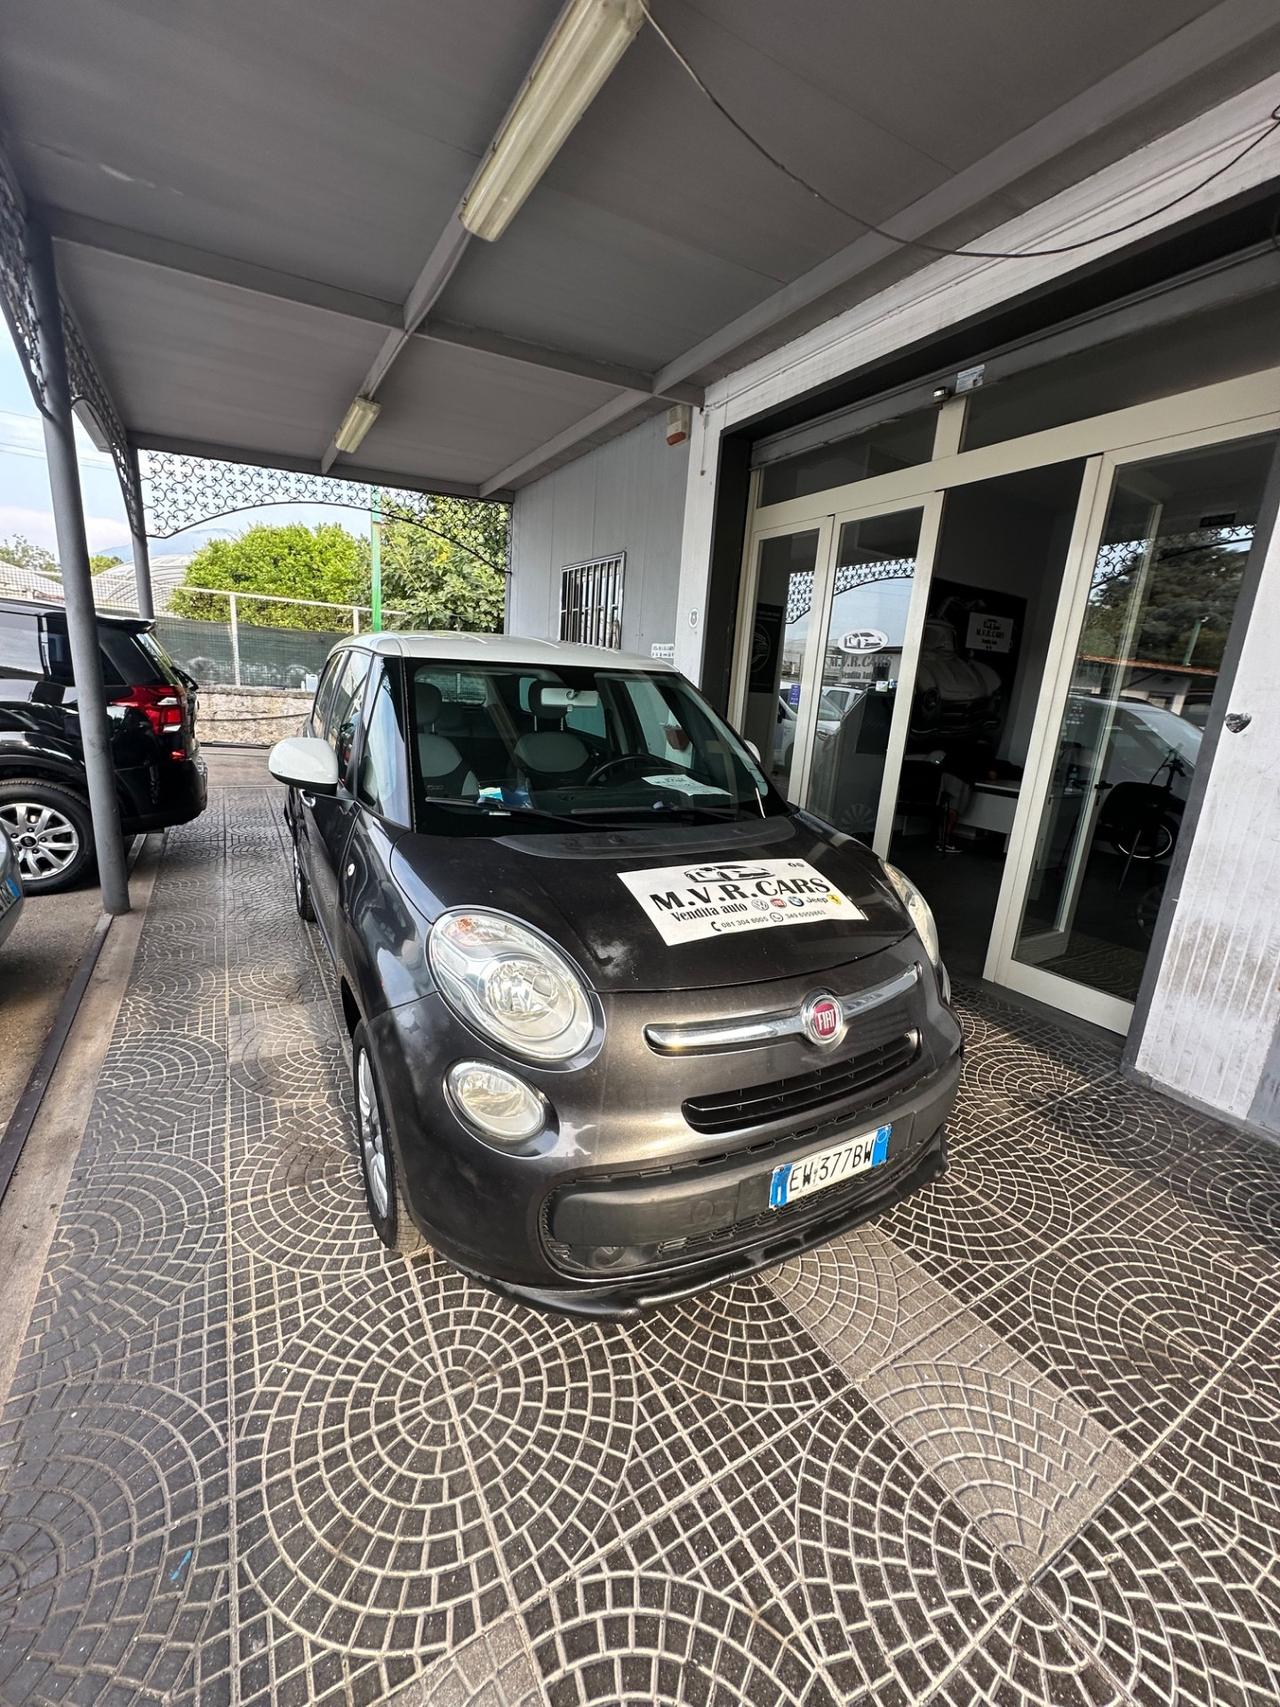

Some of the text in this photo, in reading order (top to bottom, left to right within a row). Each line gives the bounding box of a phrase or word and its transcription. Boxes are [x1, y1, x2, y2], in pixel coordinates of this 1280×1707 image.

[671, 901, 748, 923] Vendita auto
[817, 1009, 835, 1031] FIAT
